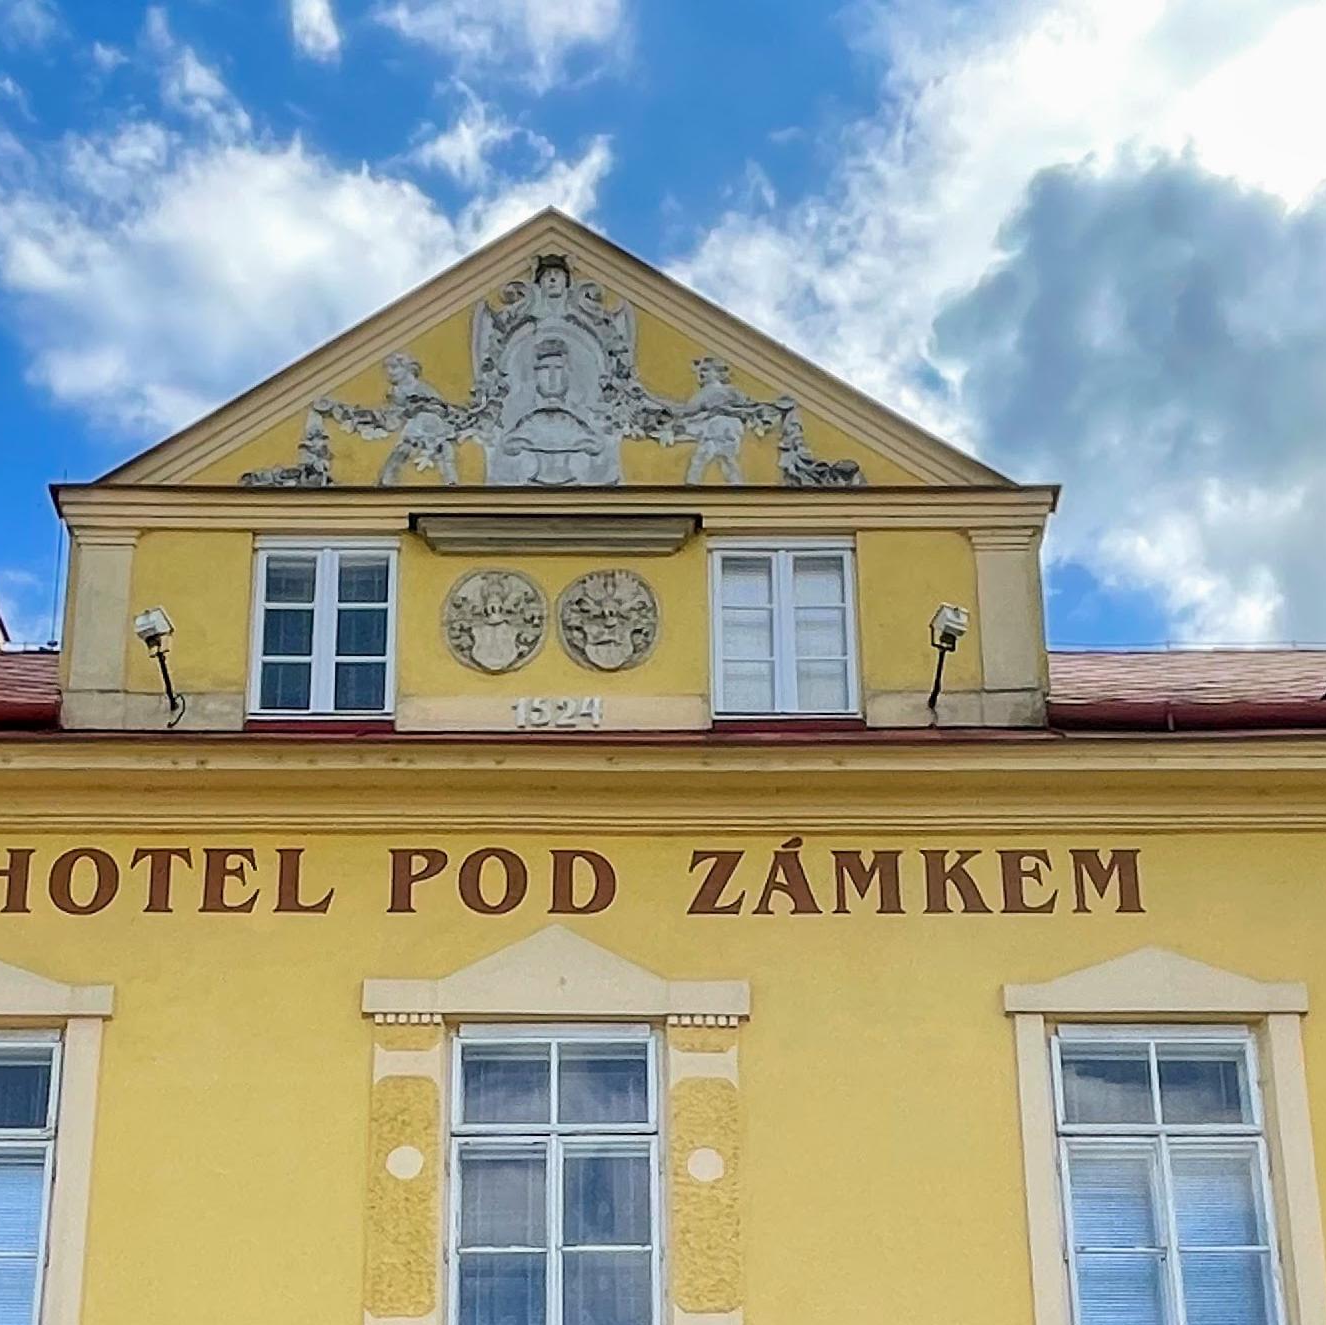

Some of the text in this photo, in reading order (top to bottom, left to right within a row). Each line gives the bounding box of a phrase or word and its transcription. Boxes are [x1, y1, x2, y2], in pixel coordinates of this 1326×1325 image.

[511, 697, 602, 728] 1524
[386, 847, 617, 915] POD
[687, 838, 1147, 915] ZÁMKEM
